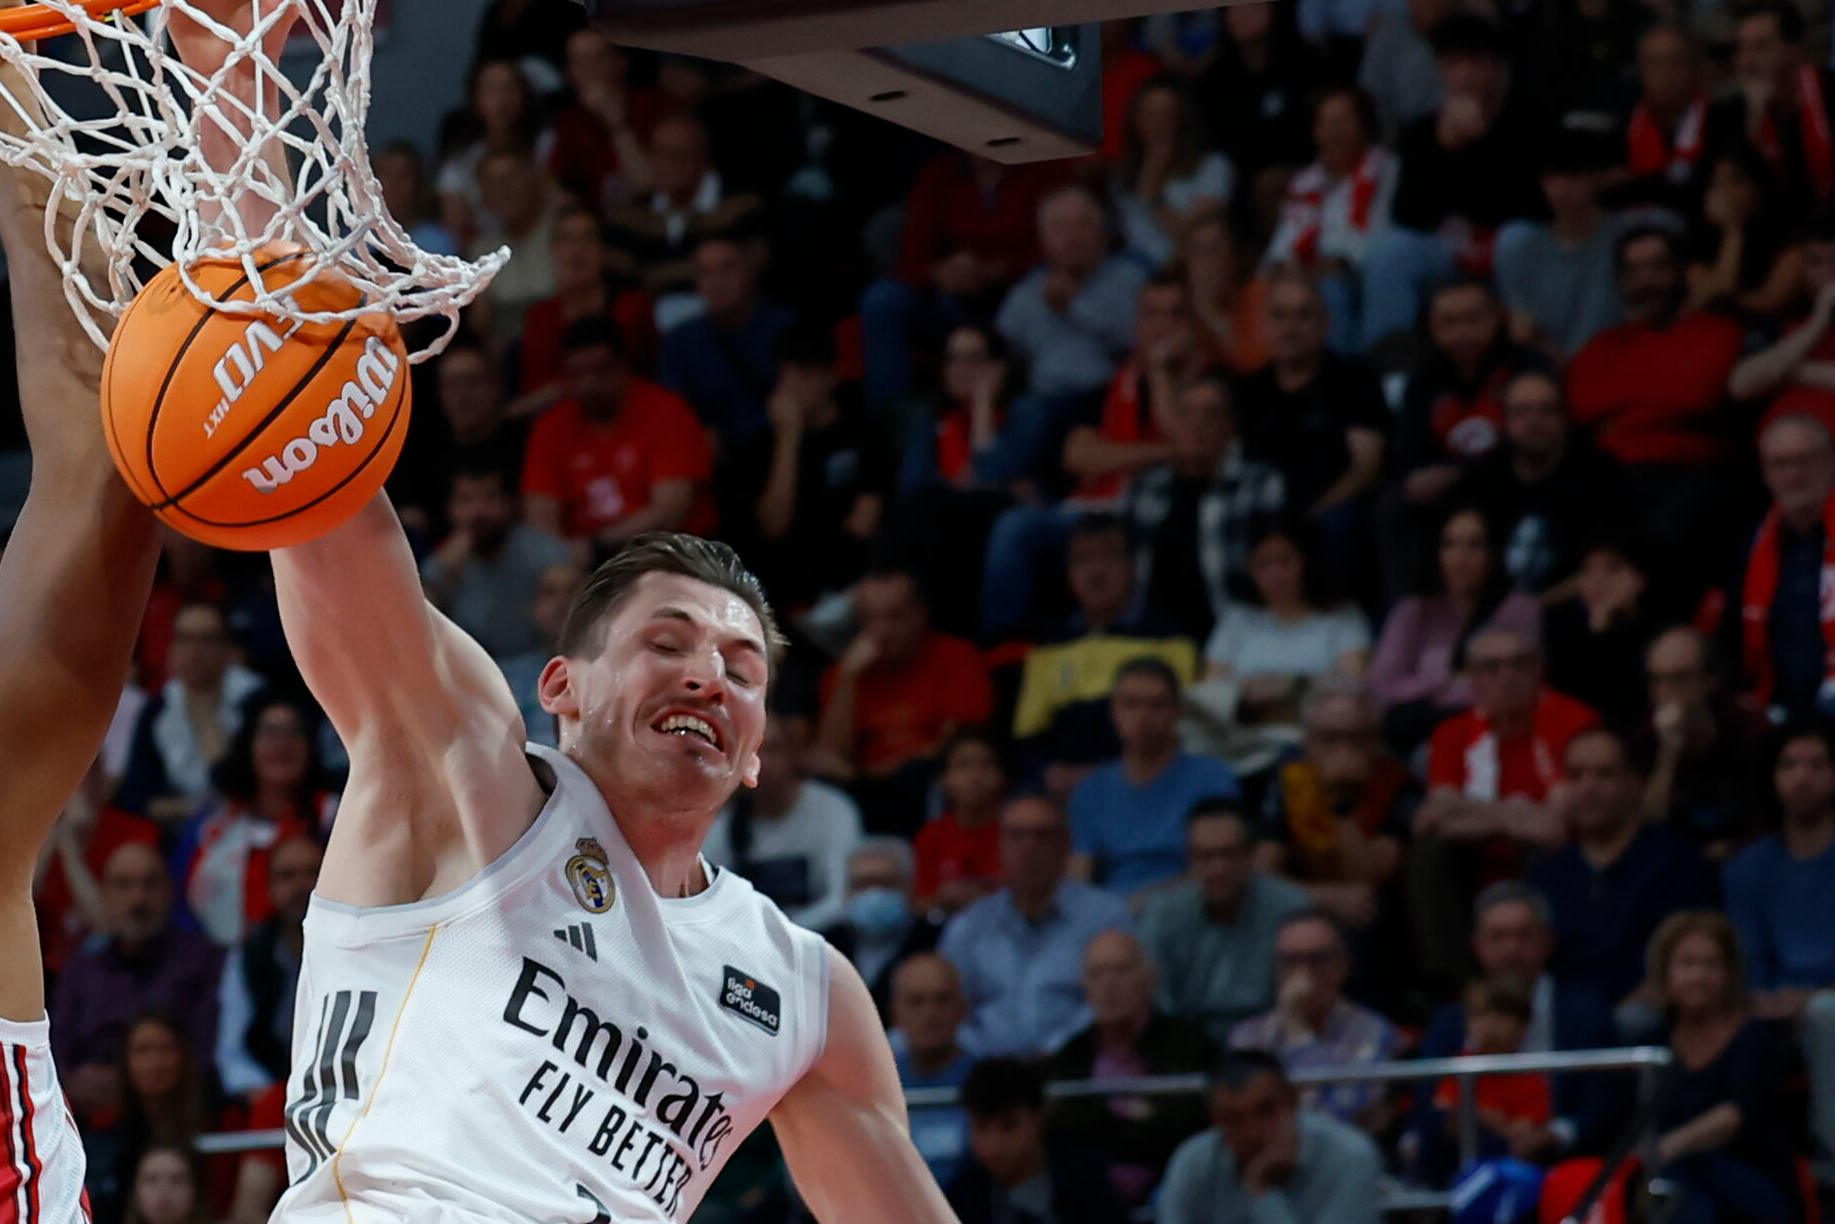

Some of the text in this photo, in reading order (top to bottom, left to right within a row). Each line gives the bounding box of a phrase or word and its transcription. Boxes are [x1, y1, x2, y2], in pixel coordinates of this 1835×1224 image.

[241, 335, 400, 494] Wilson
[502, 955, 733, 1172] Emirates
[725, 991, 779, 1028] endesa
[727, 976, 753, 1000] liga
[518, 1059, 693, 1218] FLY BETTER
